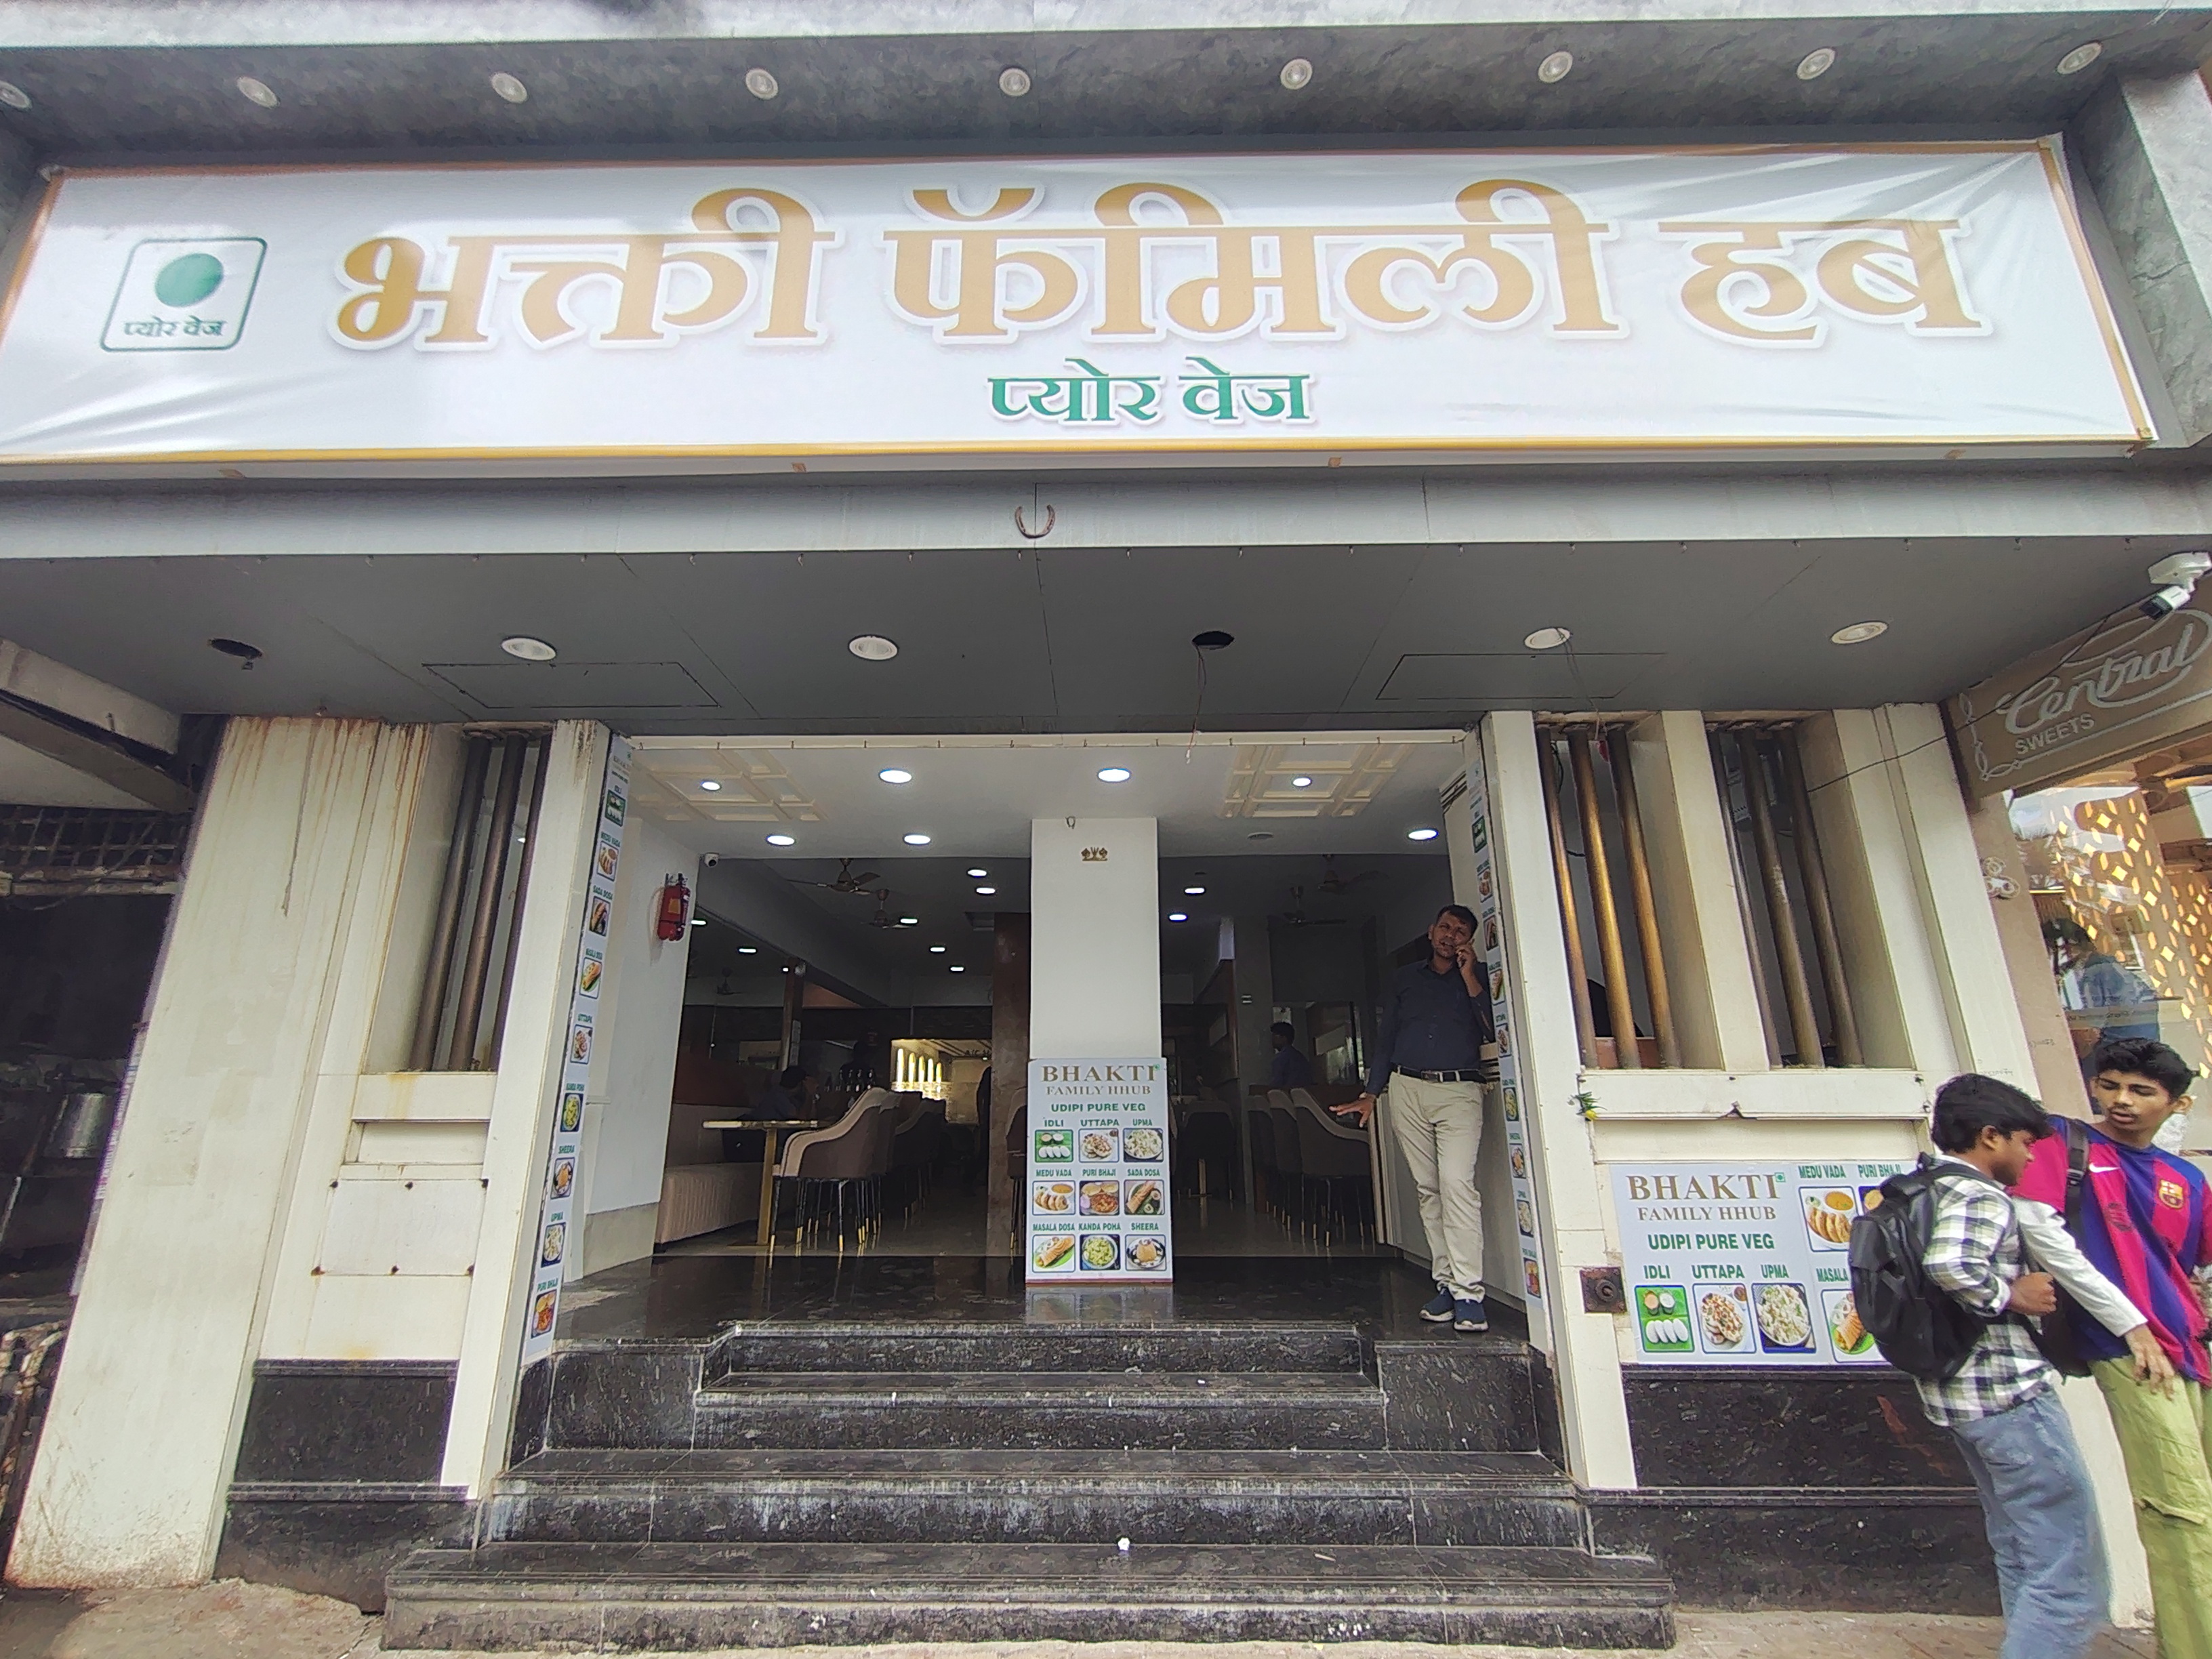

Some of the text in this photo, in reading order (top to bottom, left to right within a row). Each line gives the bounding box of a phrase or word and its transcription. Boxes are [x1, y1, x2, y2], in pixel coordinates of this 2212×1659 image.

[1658, 218, 1982, 341] हब
[124, 315, 226, 337] प्योर वेज
[987, 356, 1311, 422] प्योर वेज
[1995, 622, 2194, 735] Central
[2014, 713, 2095, 754] SWEETS
[1042, 1065, 1158, 1082] BHAKTI
[1046, 1085, 1151, 1095] FAMILY HHUB
[1051, 1103, 1145, 1112] UDIPI PURE VEG
[1080, 1119, 1120, 1127] UTTAPA
[1056, 1168, 1072, 1176] VADA
[1082, 1168, 1097, 1176] PURI
[1098, 1168, 1116, 1176] BHAJI
[1127, 1168, 1143, 1176] SADA
[1144, 1168, 1160, 1176] DOSA
[1798, 1165, 1847, 1179] MEDU VADA
[1858, 1164, 1877, 1178] PURI
[1626, 1174, 1780, 1201] BHAKTI
[1637, 1206, 1777, 1221] FAMILY HHUB
[1033, 1223, 1160, 1231] MASALA DOSA KANDA POHA SHEERA
[1647, 1233, 1775, 1250] UDIPI PURE VEG
[1643, 1264, 1789, 1279] IDLI UTTAPA UPMA
[1816, 1267, 1849, 1282] MASALA
